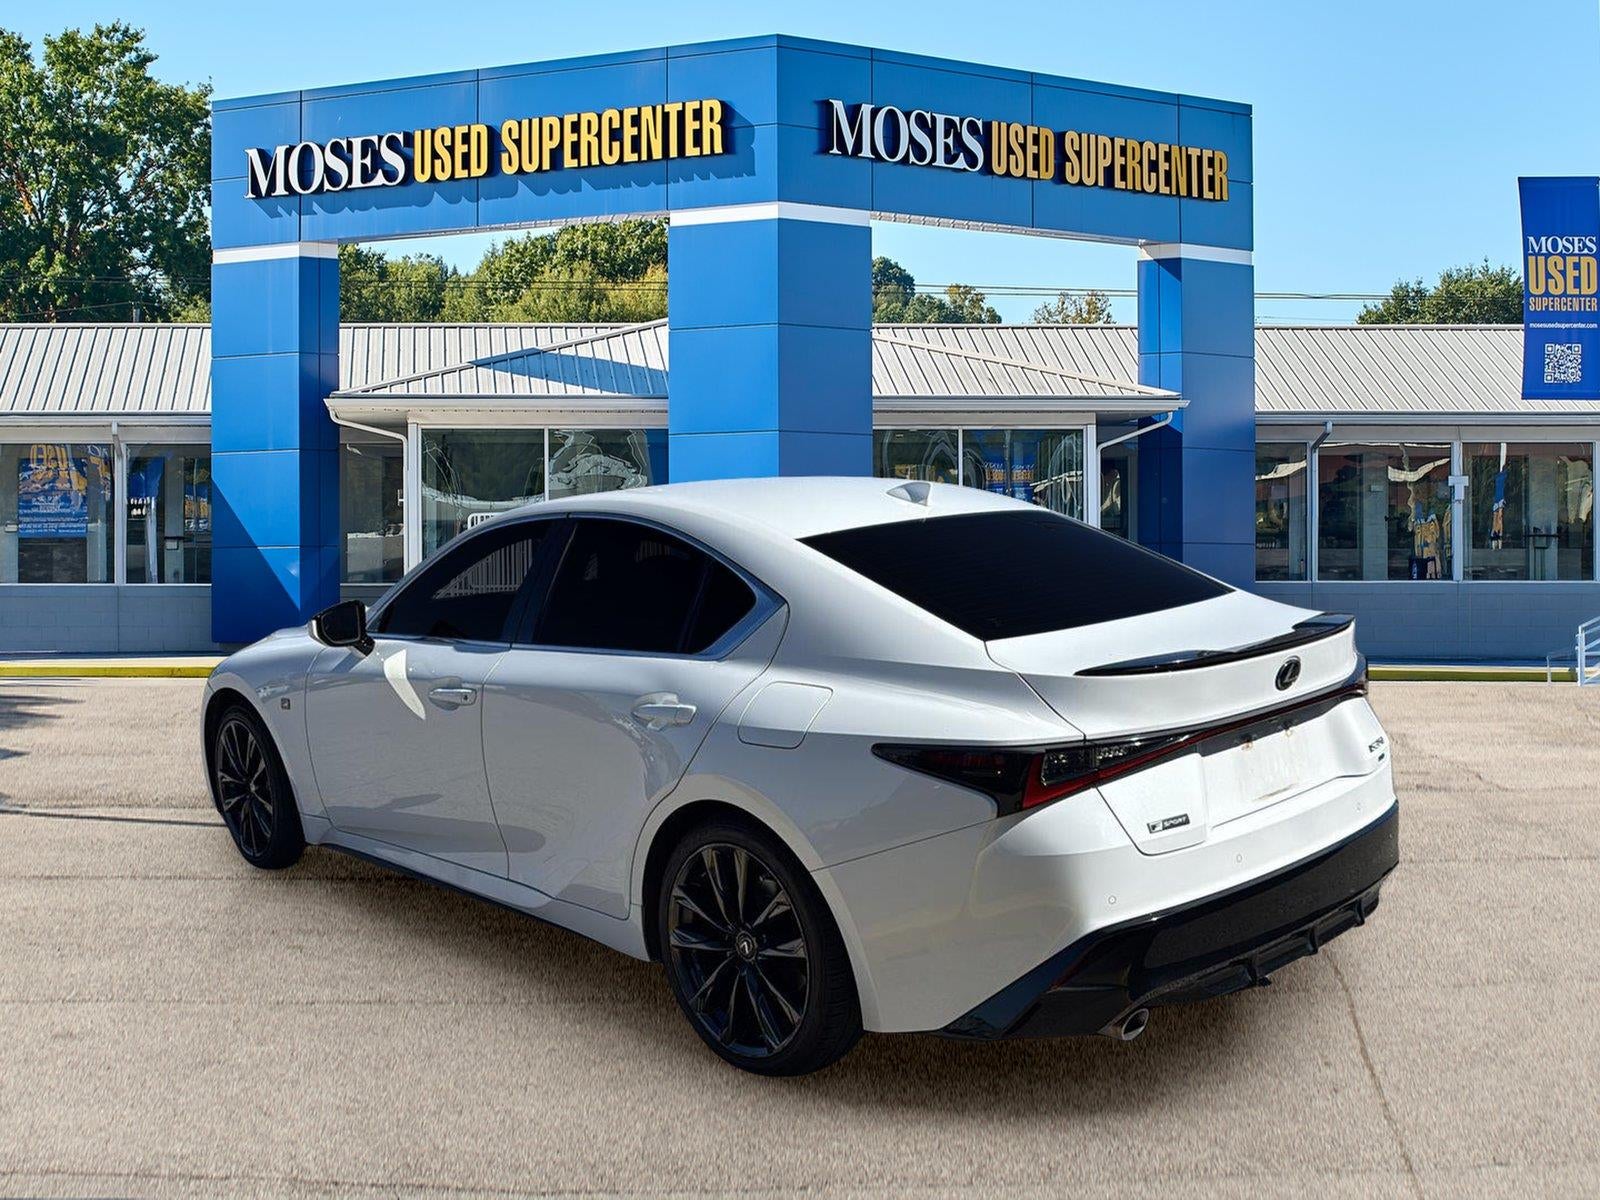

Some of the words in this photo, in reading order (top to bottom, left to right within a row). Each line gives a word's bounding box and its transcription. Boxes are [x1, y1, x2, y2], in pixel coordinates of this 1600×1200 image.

[245, 131, 406, 199] MOSES
[412, 123, 489, 183] USED
[500, 98, 724, 175] SUPERCENTER
[828, 98, 984, 172] MOSES
[991, 120, 1055, 181] USED
[1064, 130, 1229, 201] SUPERCENTER
[1527, 236, 1597, 255] MOSES
[1528, 256, 1598, 295] USED
[1529, 297, 1598, 312] SUPERCENTER
